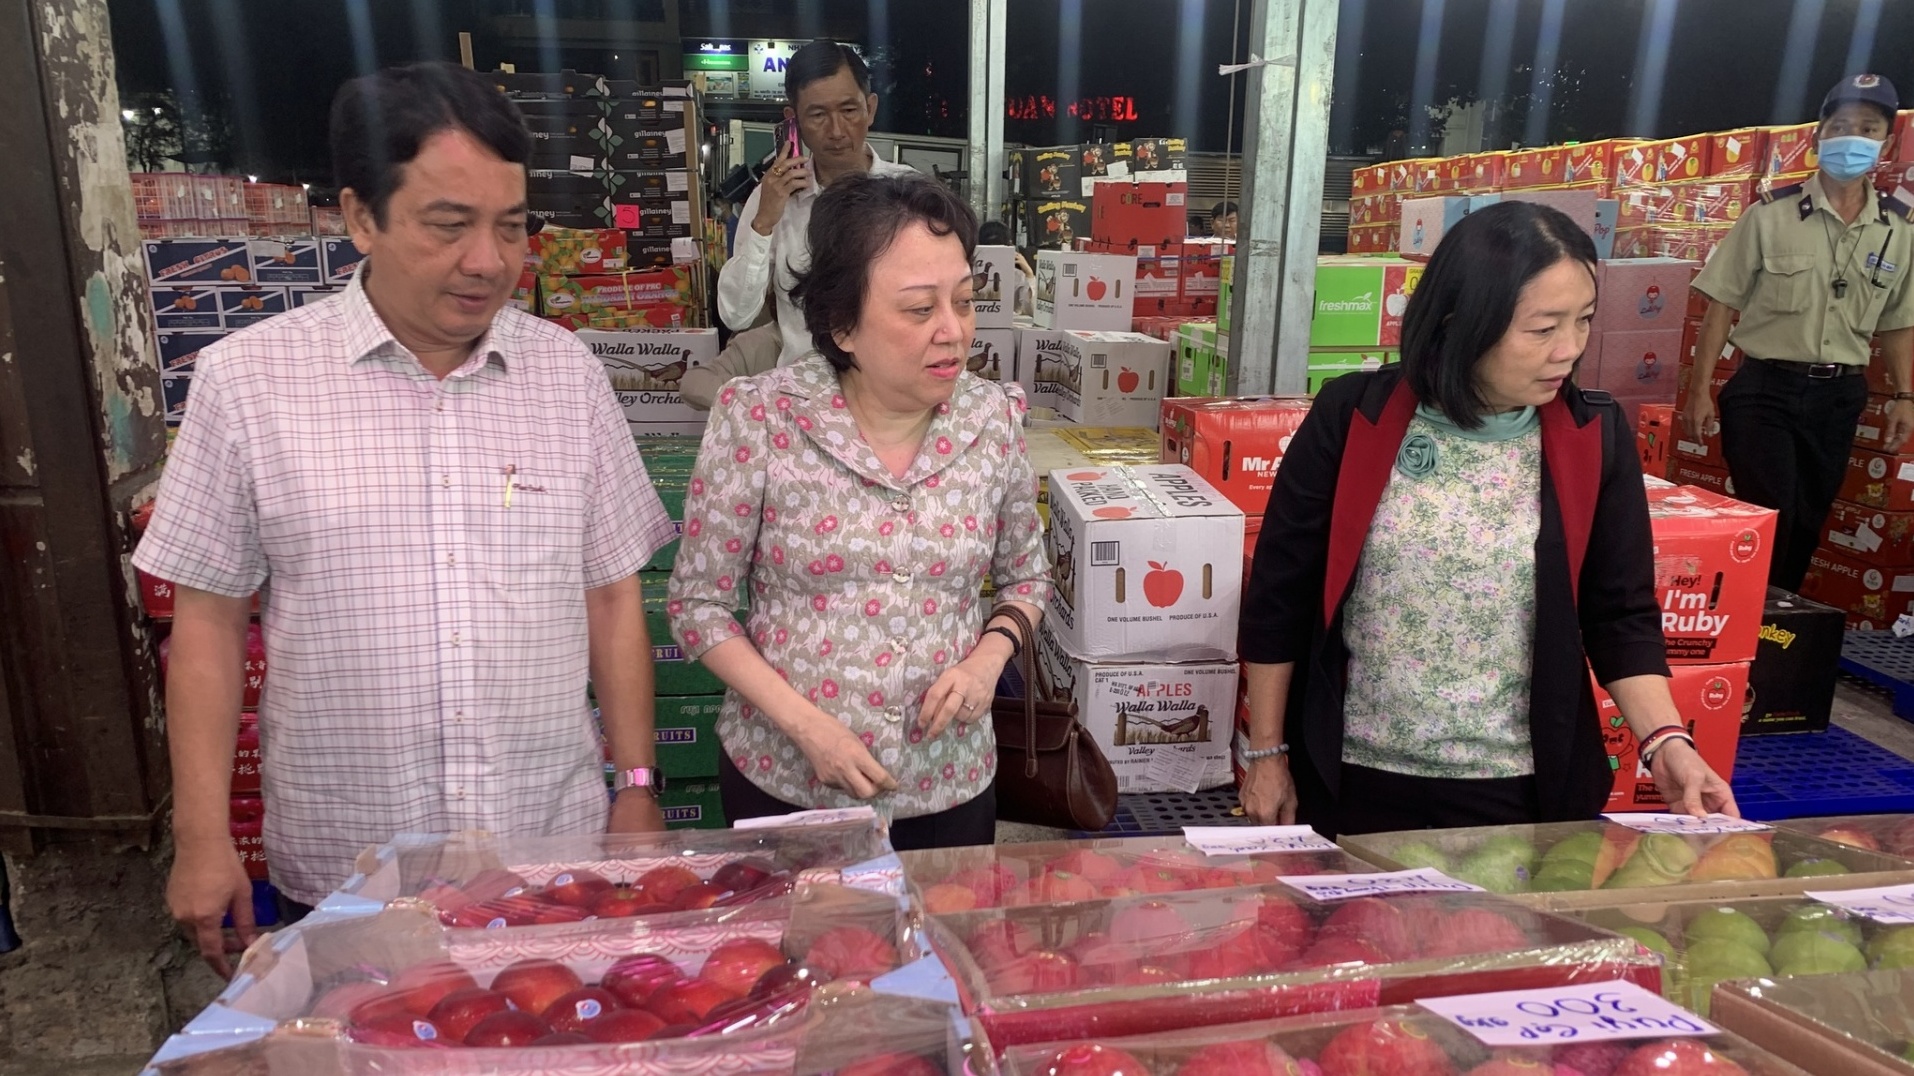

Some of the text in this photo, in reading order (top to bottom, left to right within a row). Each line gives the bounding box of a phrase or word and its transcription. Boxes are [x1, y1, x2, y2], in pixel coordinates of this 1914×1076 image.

[1008, 95, 1056, 120] UAN
[1120, 193, 1142, 205] CORE
[622, 206, 636, 224] 5
[639, 208, 672, 217] gillainey
[642, 246, 672, 254] gillaine
[159, 260, 189, 277] FRESH
[975, 302, 1001, 313] ards
[1319, 300, 1372, 311] freshmax
[591, 343, 681, 356] Walla Walla
[1036, 339, 1062, 351] Wal
[640, 392, 684, 404] Orcha
[1242, 457, 1271, 471] Mr
[1848, 457, 1864, 468] PLE
[1680, 468, 1722, 486] FRESH APPLE
[1071, 482, 1108, 507] PACKED
[1148, 472, 1213, 509] APPLES
[1811, 556, 1860, 579] RESH APPLE
[1670, 575, 1702, 588] Hey!
[1664, 589, 1707, 609] I'm
[1662, 611, 1730, 637] Ruby
[1677, 639, 1713, 648] Crunchy
[652, 648, 679, 659] RUI
[1114, 700, 1196, 713] Walla Walla
[653, 731, 691, 741] RUITS
[1128, 746, 1155, 756] Valley
[662, 809, 696, 819] RUITS
[1517, 992, 1637, 1017] 300
